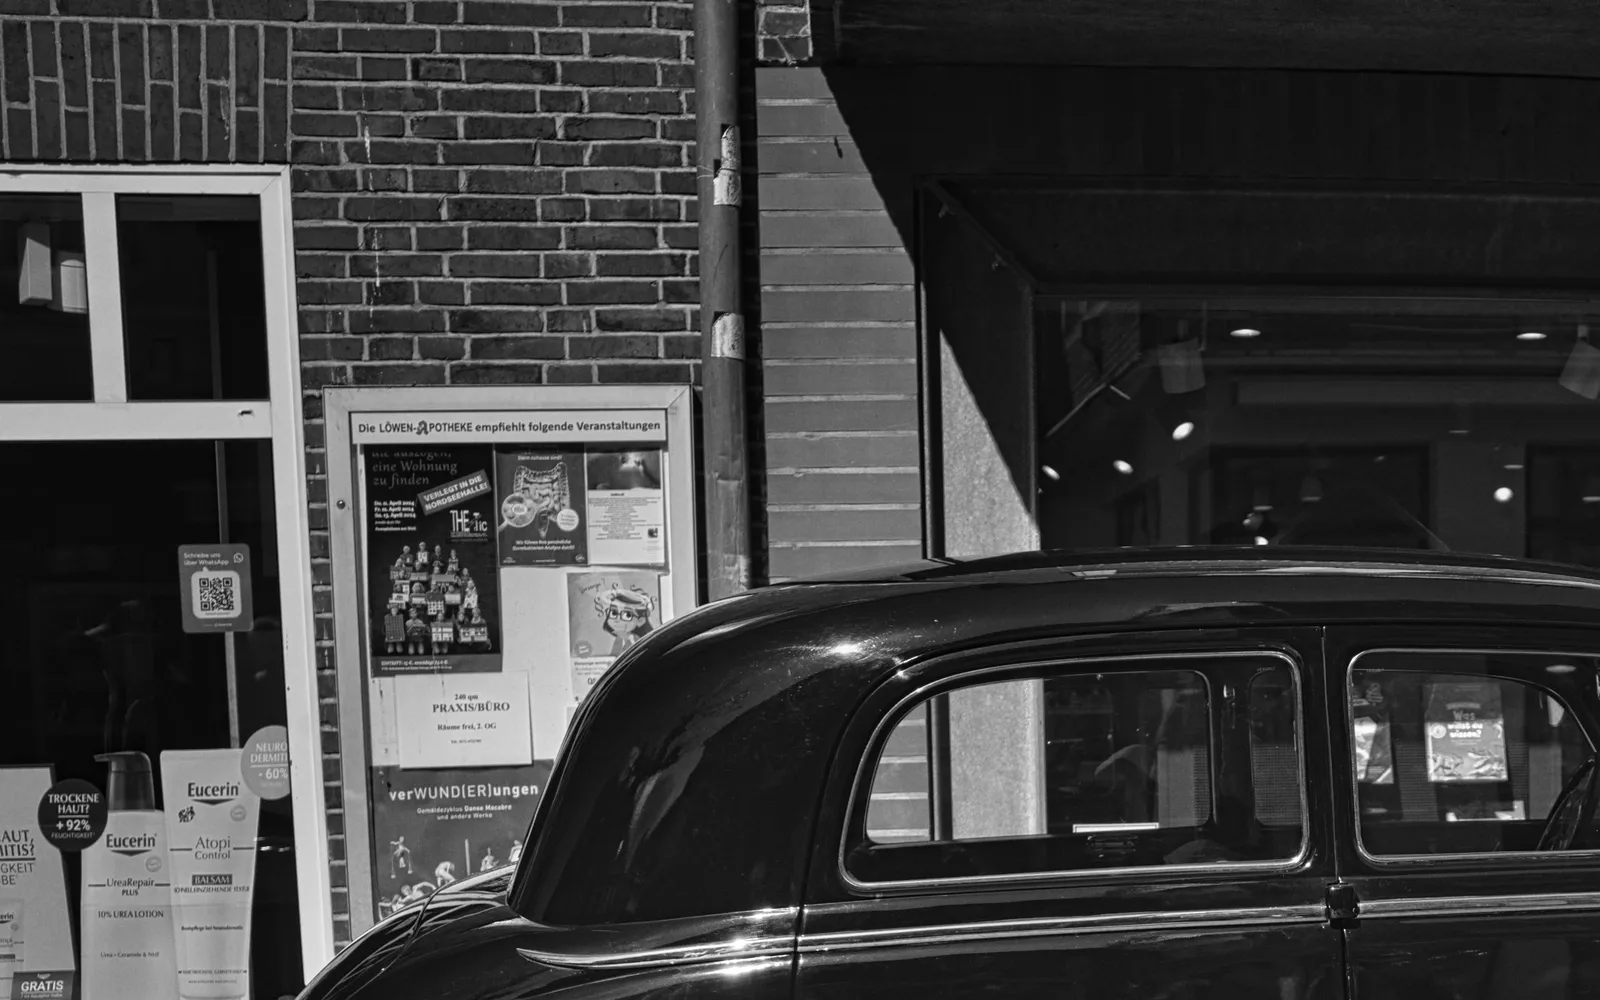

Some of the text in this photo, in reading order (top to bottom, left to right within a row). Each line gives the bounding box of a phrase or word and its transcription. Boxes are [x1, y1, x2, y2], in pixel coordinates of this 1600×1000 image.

[358, 423, 376, 434] Die
[475, 421, 525, 434] empfiehlt
[528, 420, 574, 434] folgende
[576, 420, 661, 433] Veranstaltungen
[372, 459, 458, 475] eine Wohnung
[373, 472, 430, 490] zu finden
[423, 475, 483, 502] VERLEGT IN DIE
[424, 482, 488, 511] NORDSEEHALLE!
[432, 701, 510, 713] PRAXIS/BÜRO
[1452, 710, 1476, 721] Was
[437, 723, 461, 731] Räume
[462, 723, 476, 731] frei,
[1447, 722, 1471, 730] willst
[1449, 730, 1482, 738] wissen?
[256, 742, 288, 752] NEURO
[250, 753, 288, 763] DERMITI
[265, 768, 289, 780] 60%
[187, 782, 240, 798] Eucerin
[48, 794, 99, 804] TROCKENE
[57, 803, 90, 815] HAUT?
[417, 804, 512, 815] Gemäldezyklus Danse Macabre
[436, 811, 493, 820] und andere Werke
[65, 819, 91, 831] 92%
[106, 833, 158, 849] Eucerin
[195, 836, 231, 852] Atopi
[194, 850, 231, 860] Control
[0, 863, 35, 873] GKEIT
[106, 877, 155, 889] UreaRepair
[194, 875, 231, 885] BALSAM
[121, 888, 139, 897] PLUS
[98, 910, 164, 919] 10% UREA LOTION
[20, 980, 64, 992] GRATIS
